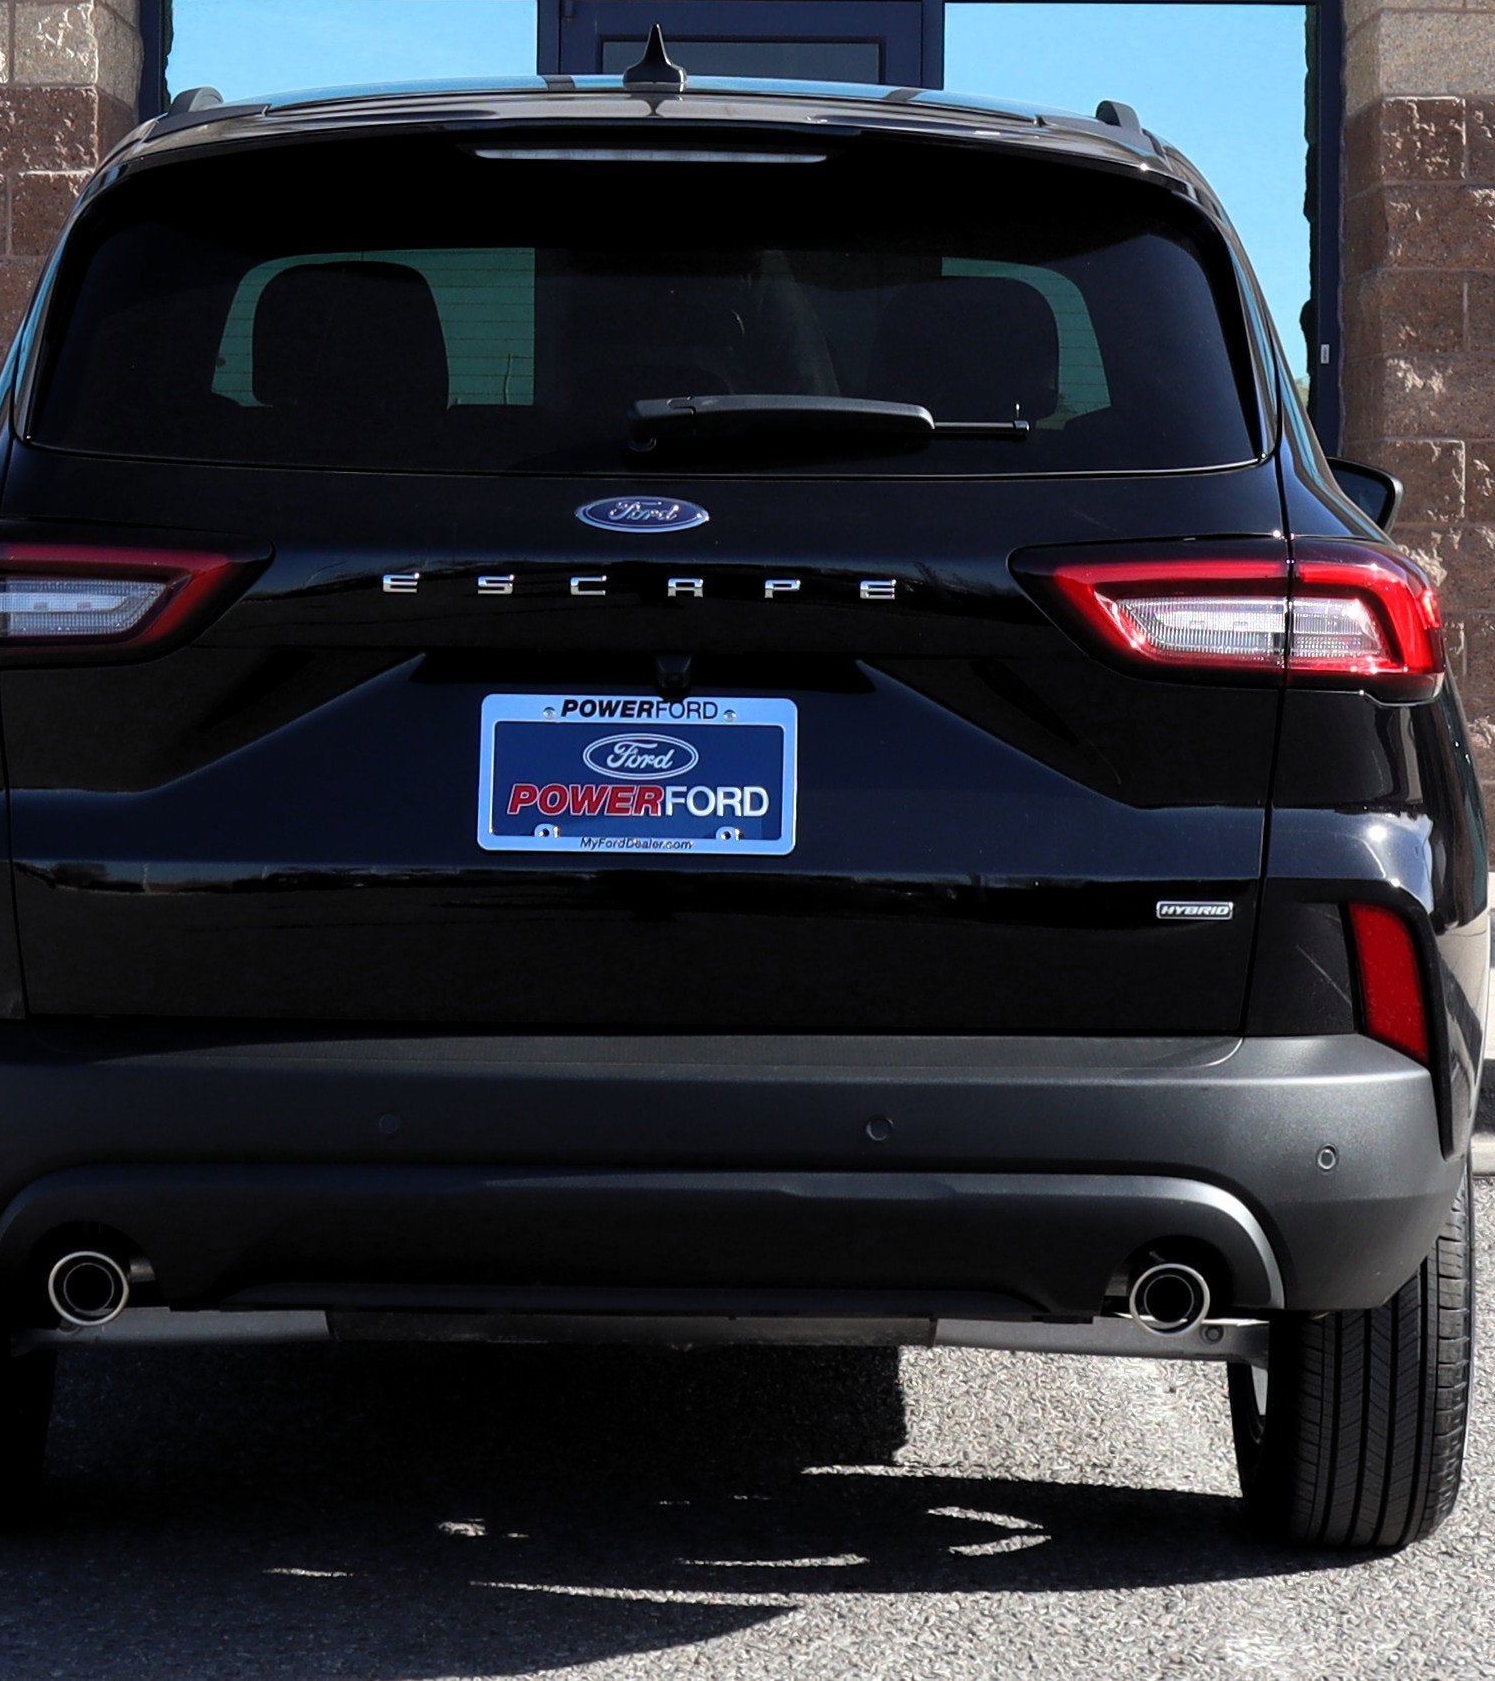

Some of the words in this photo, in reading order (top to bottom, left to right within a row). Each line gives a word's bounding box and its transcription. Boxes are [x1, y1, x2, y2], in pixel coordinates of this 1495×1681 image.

[608, 500, 680, 521] Ford
[382, 572, 897, 601] ESCAPE
[606, 740, 675, 769] Ford
[580, 836, 694, 851] MyFordDealer.com
[1161, 905, 1230, 916] HYBRID
